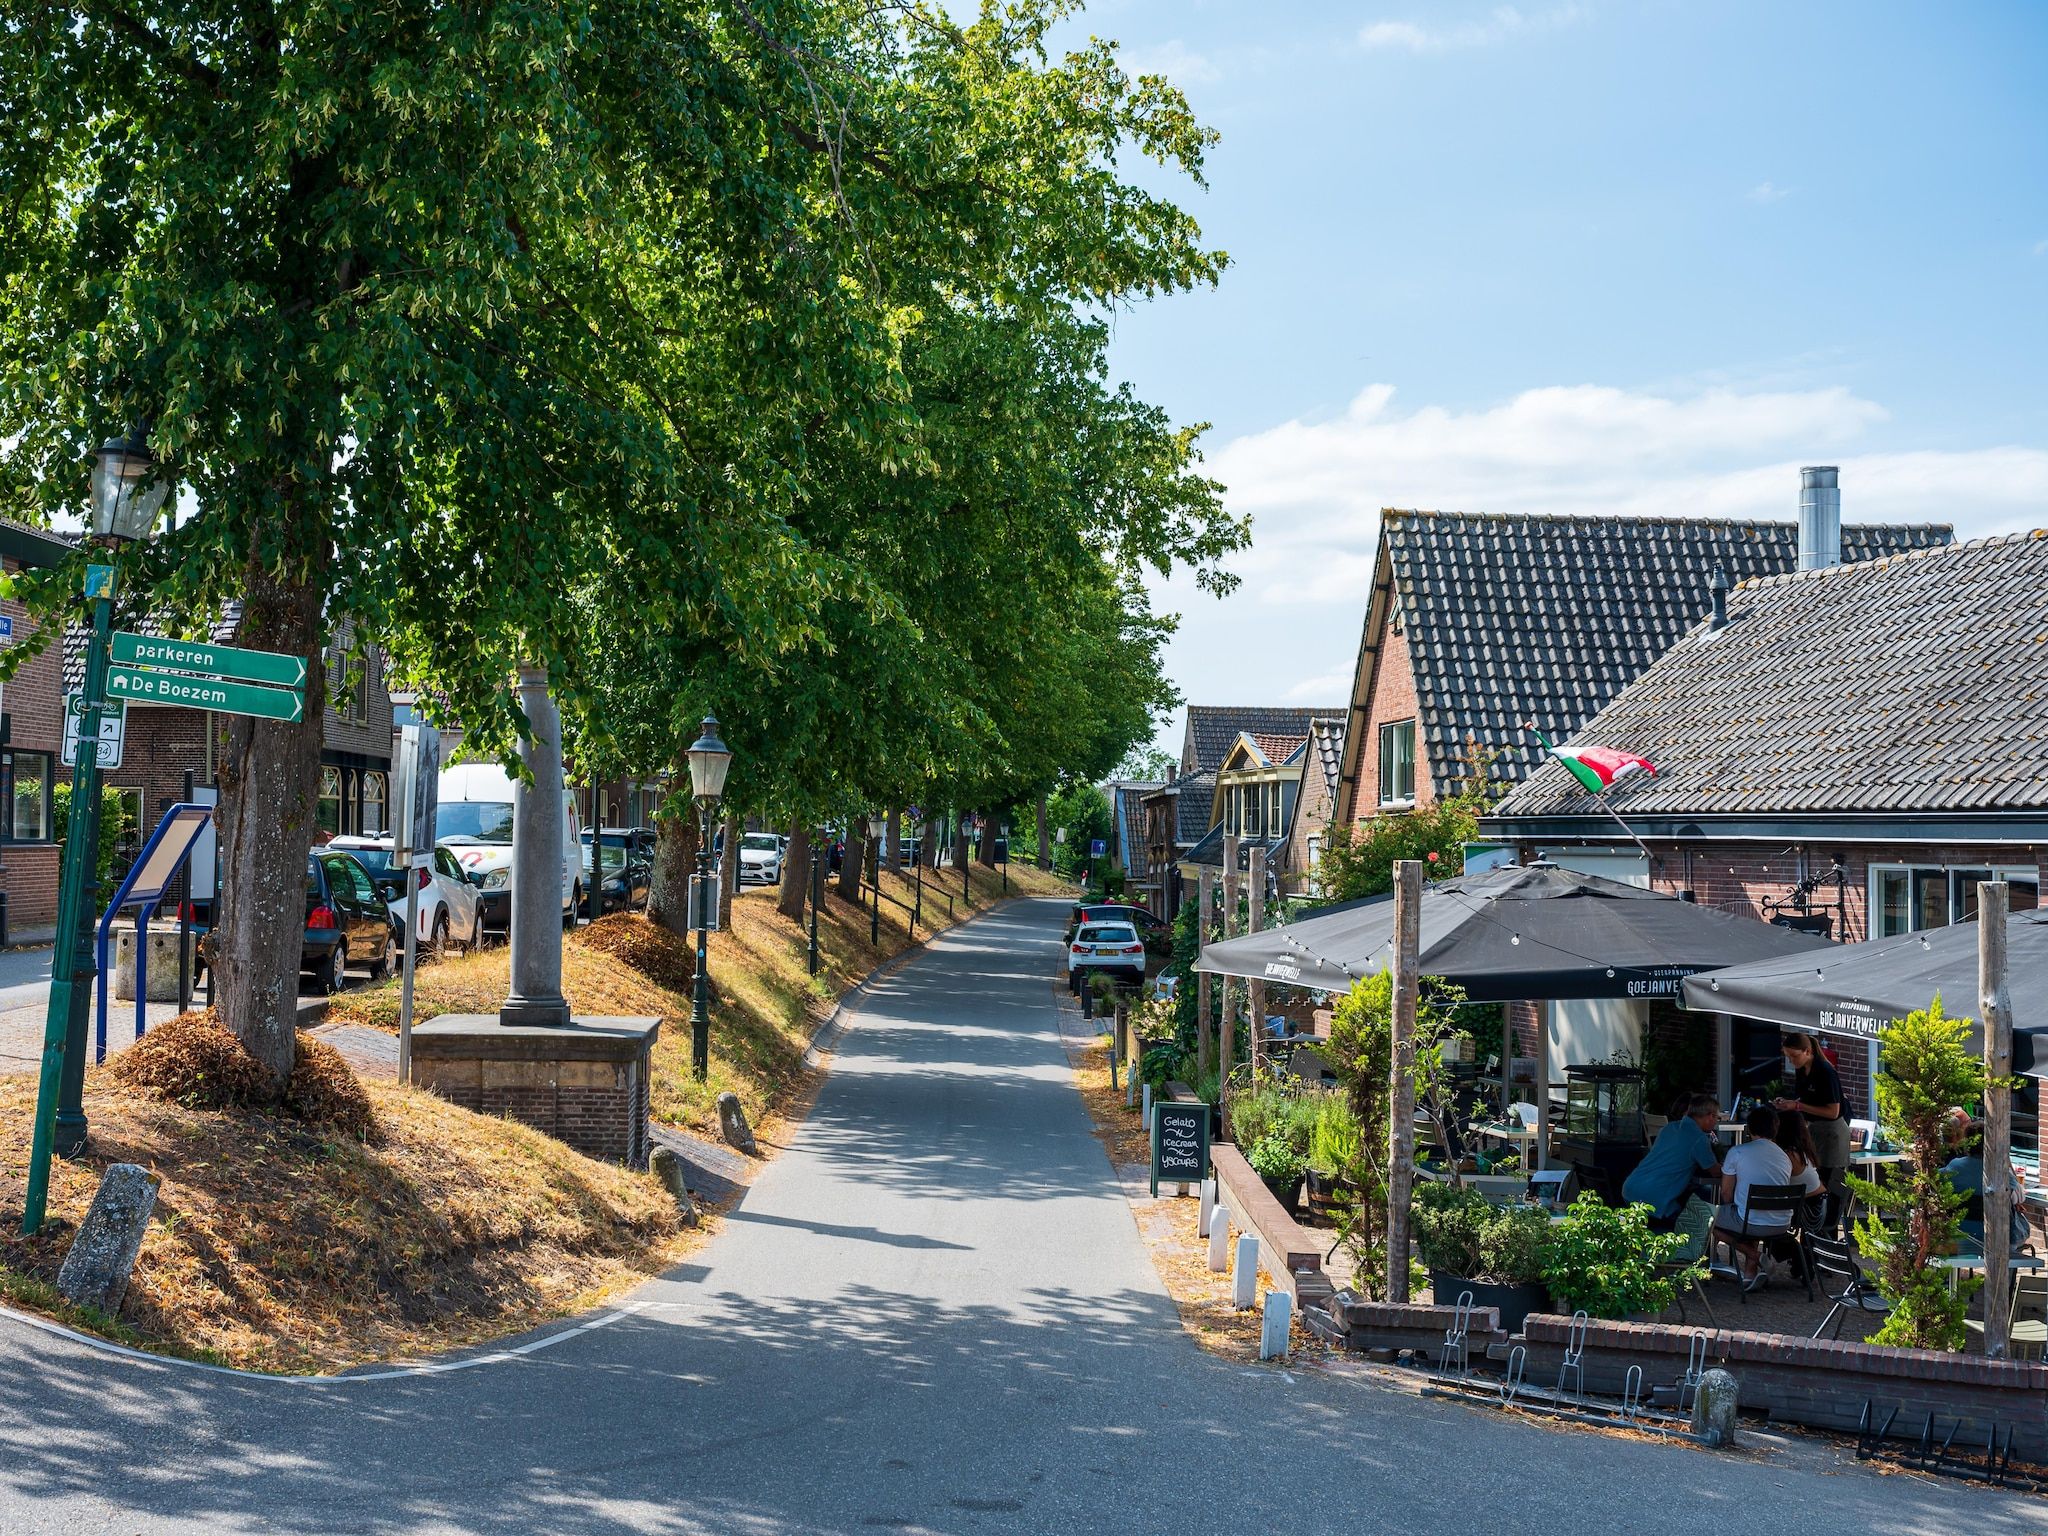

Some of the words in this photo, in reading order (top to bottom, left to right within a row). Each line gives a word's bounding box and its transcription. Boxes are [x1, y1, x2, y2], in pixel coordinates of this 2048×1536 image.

[135, 645, 214, 666] parkeren
[132, 676, 154, 693] De
[159, 680, 226, 703] Boezem
[1627, 980, 1679, 996] GOEJANVE
[1819, 1010, 1889, 1035] GOEJANVERWELLE
[1163, 1116, 1196, 1128] Gelato
